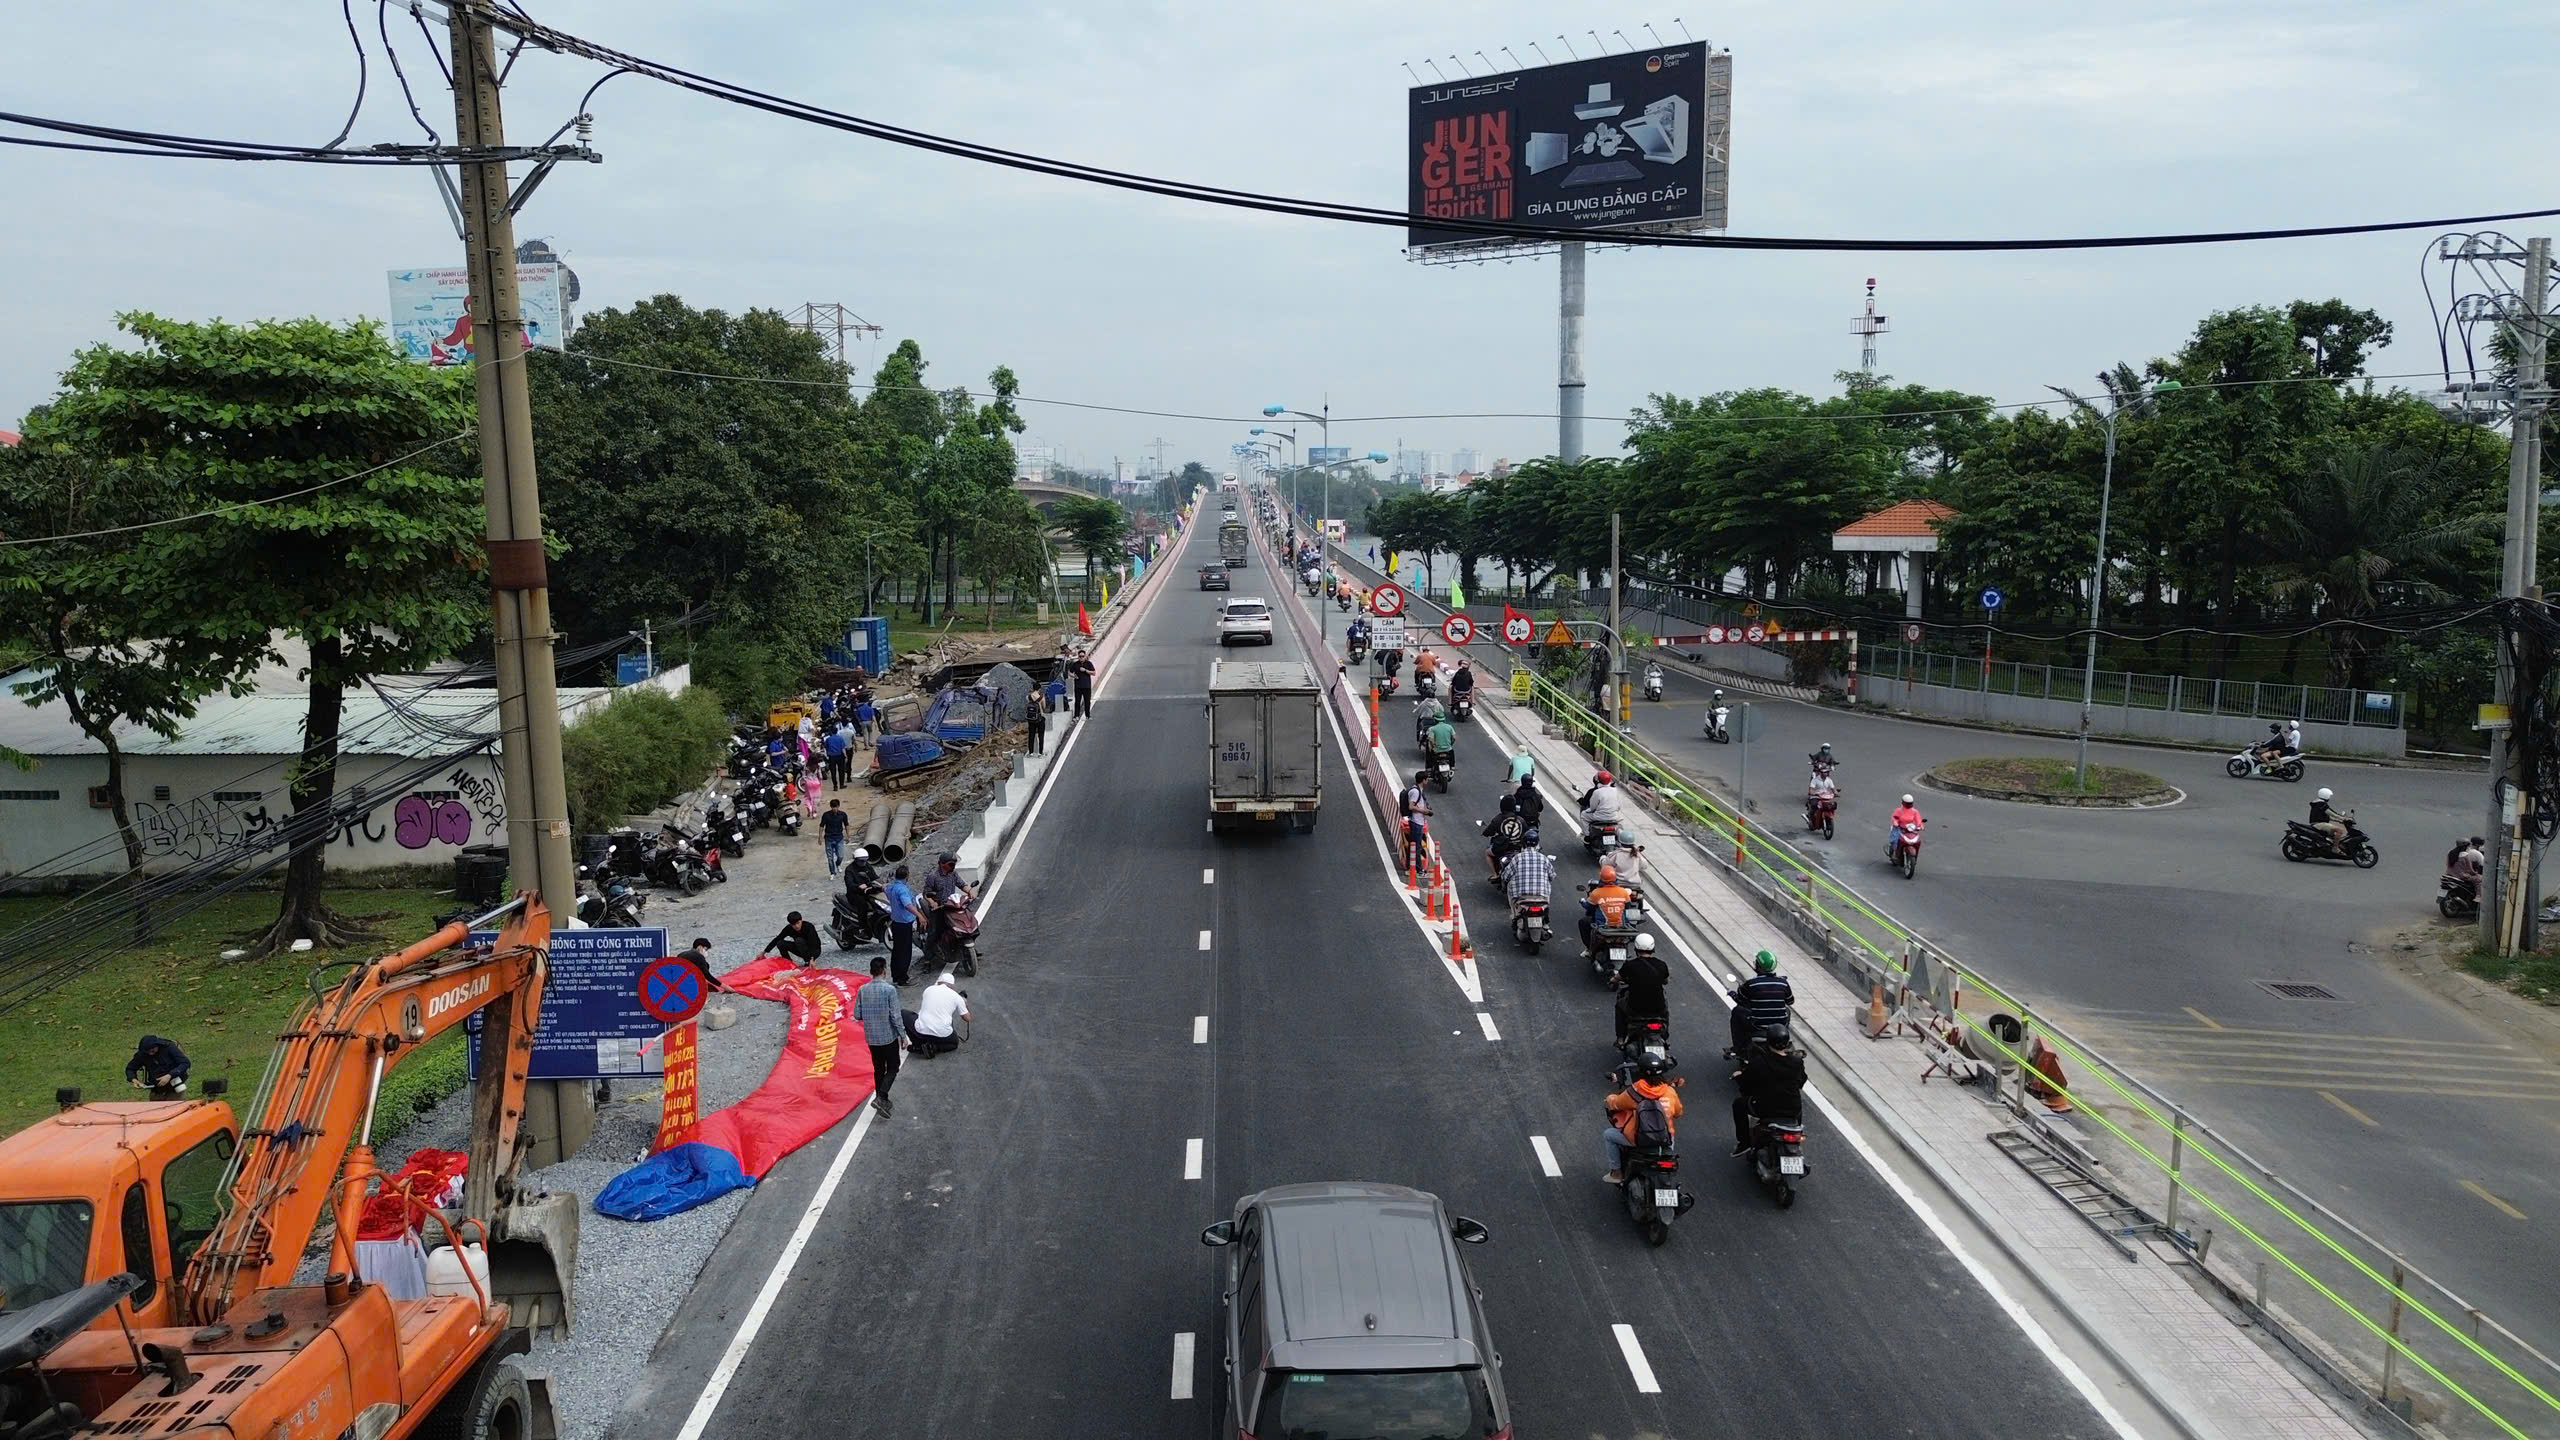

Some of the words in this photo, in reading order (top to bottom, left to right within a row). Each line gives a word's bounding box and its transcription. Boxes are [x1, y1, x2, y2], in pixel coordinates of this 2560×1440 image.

[1664, 52, 1690, 62] German
[1421, 80, 1517, 104] JUNGER
[1422, 110, 1507, 153] JUN
[1421, 143, 1512, 188] GER
[1470, 180, 1509, 192] GERMAN
[1556, 197, 1600, 215] DỤNG
[1602, 187, 1647, 207] ĐẲNG
[1651, 181, 1688, 202] CẤP
[1573, 207, 1636, 221] www.junger.vn
[551, 936, 576, 949] HÔNG
[579, 939, 594, 949] TIN
[597, 936, 621, 948] CÔNG
[625, 935, 653, 948] TRÌNH
[428, 973, 491, 1019] DOOSAN
[404, 1004, 418, 1030] 19
